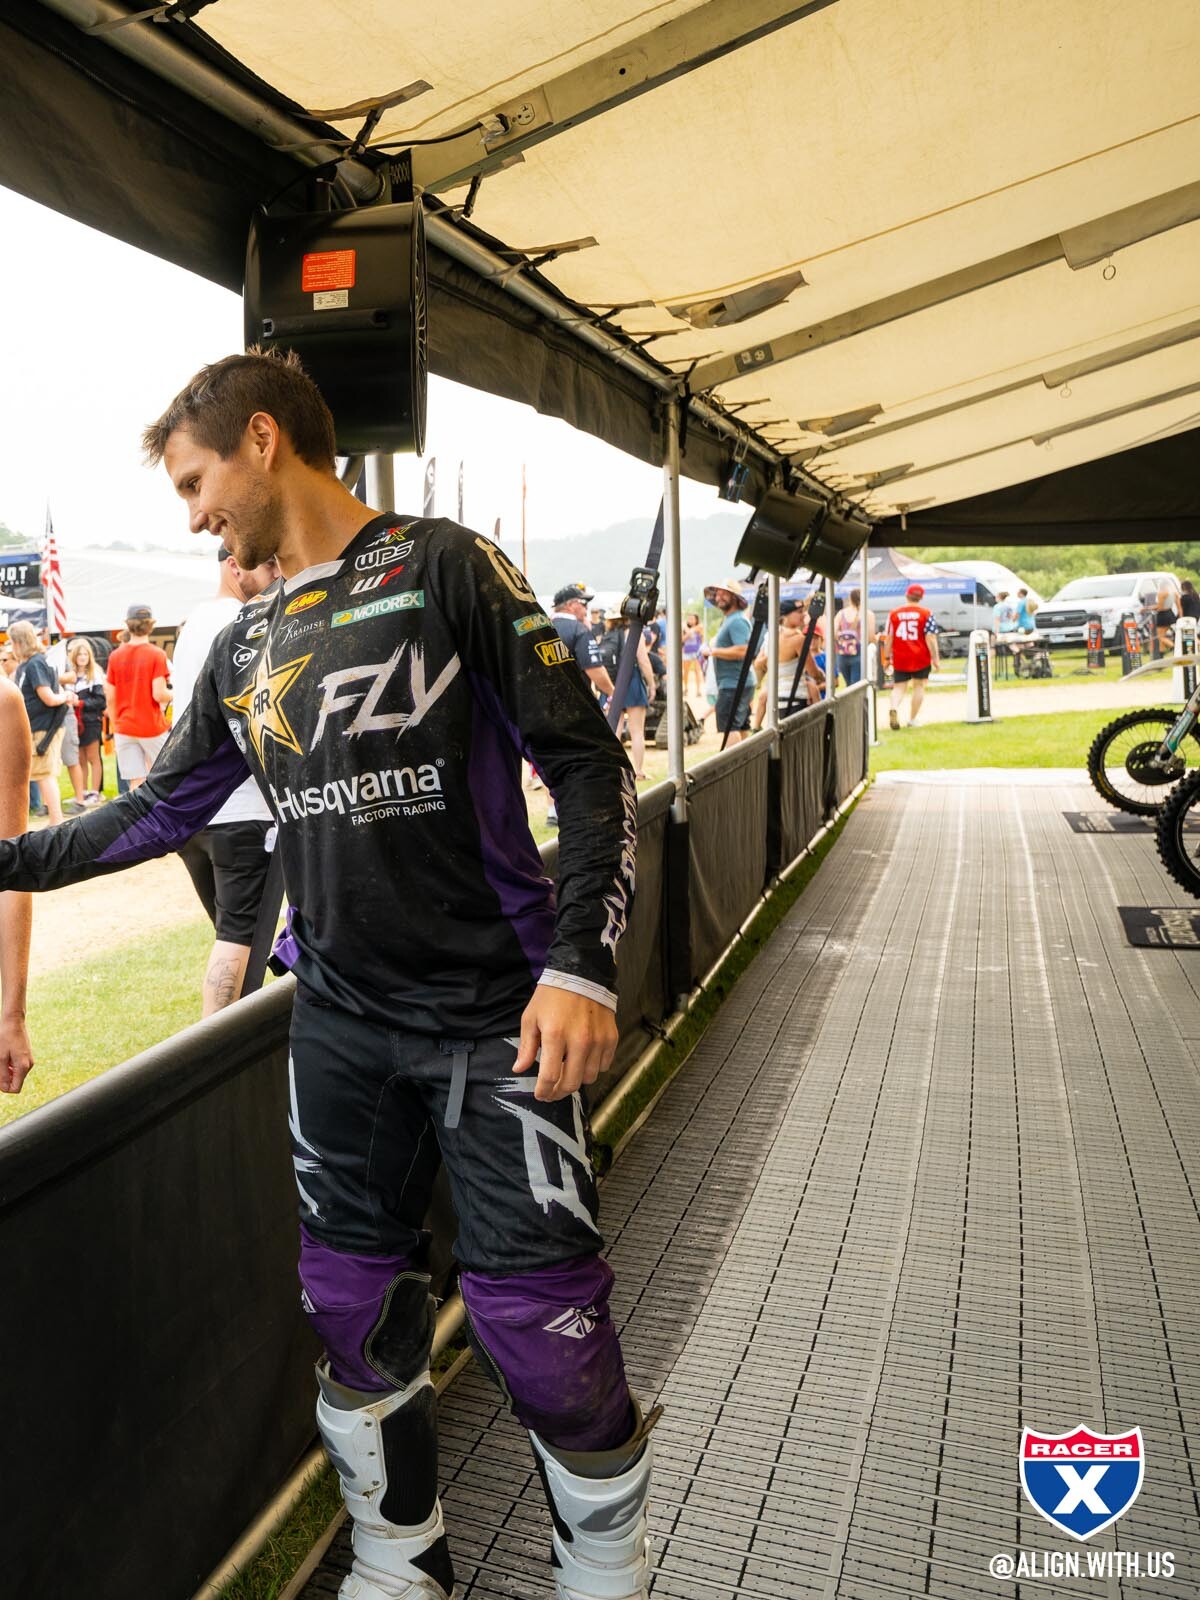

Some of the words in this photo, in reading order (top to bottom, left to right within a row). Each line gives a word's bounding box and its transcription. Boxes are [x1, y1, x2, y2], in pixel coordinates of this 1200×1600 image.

[355, 540, 415, 571] WPS
[353, 592, 420, 621] MOTOREX
[896, 620, 919, 641] 45
[309, 639, 461, 753] FLY
[351, 806, 402, 826] FACTORY
[403, 800, 446, 816] RACING
